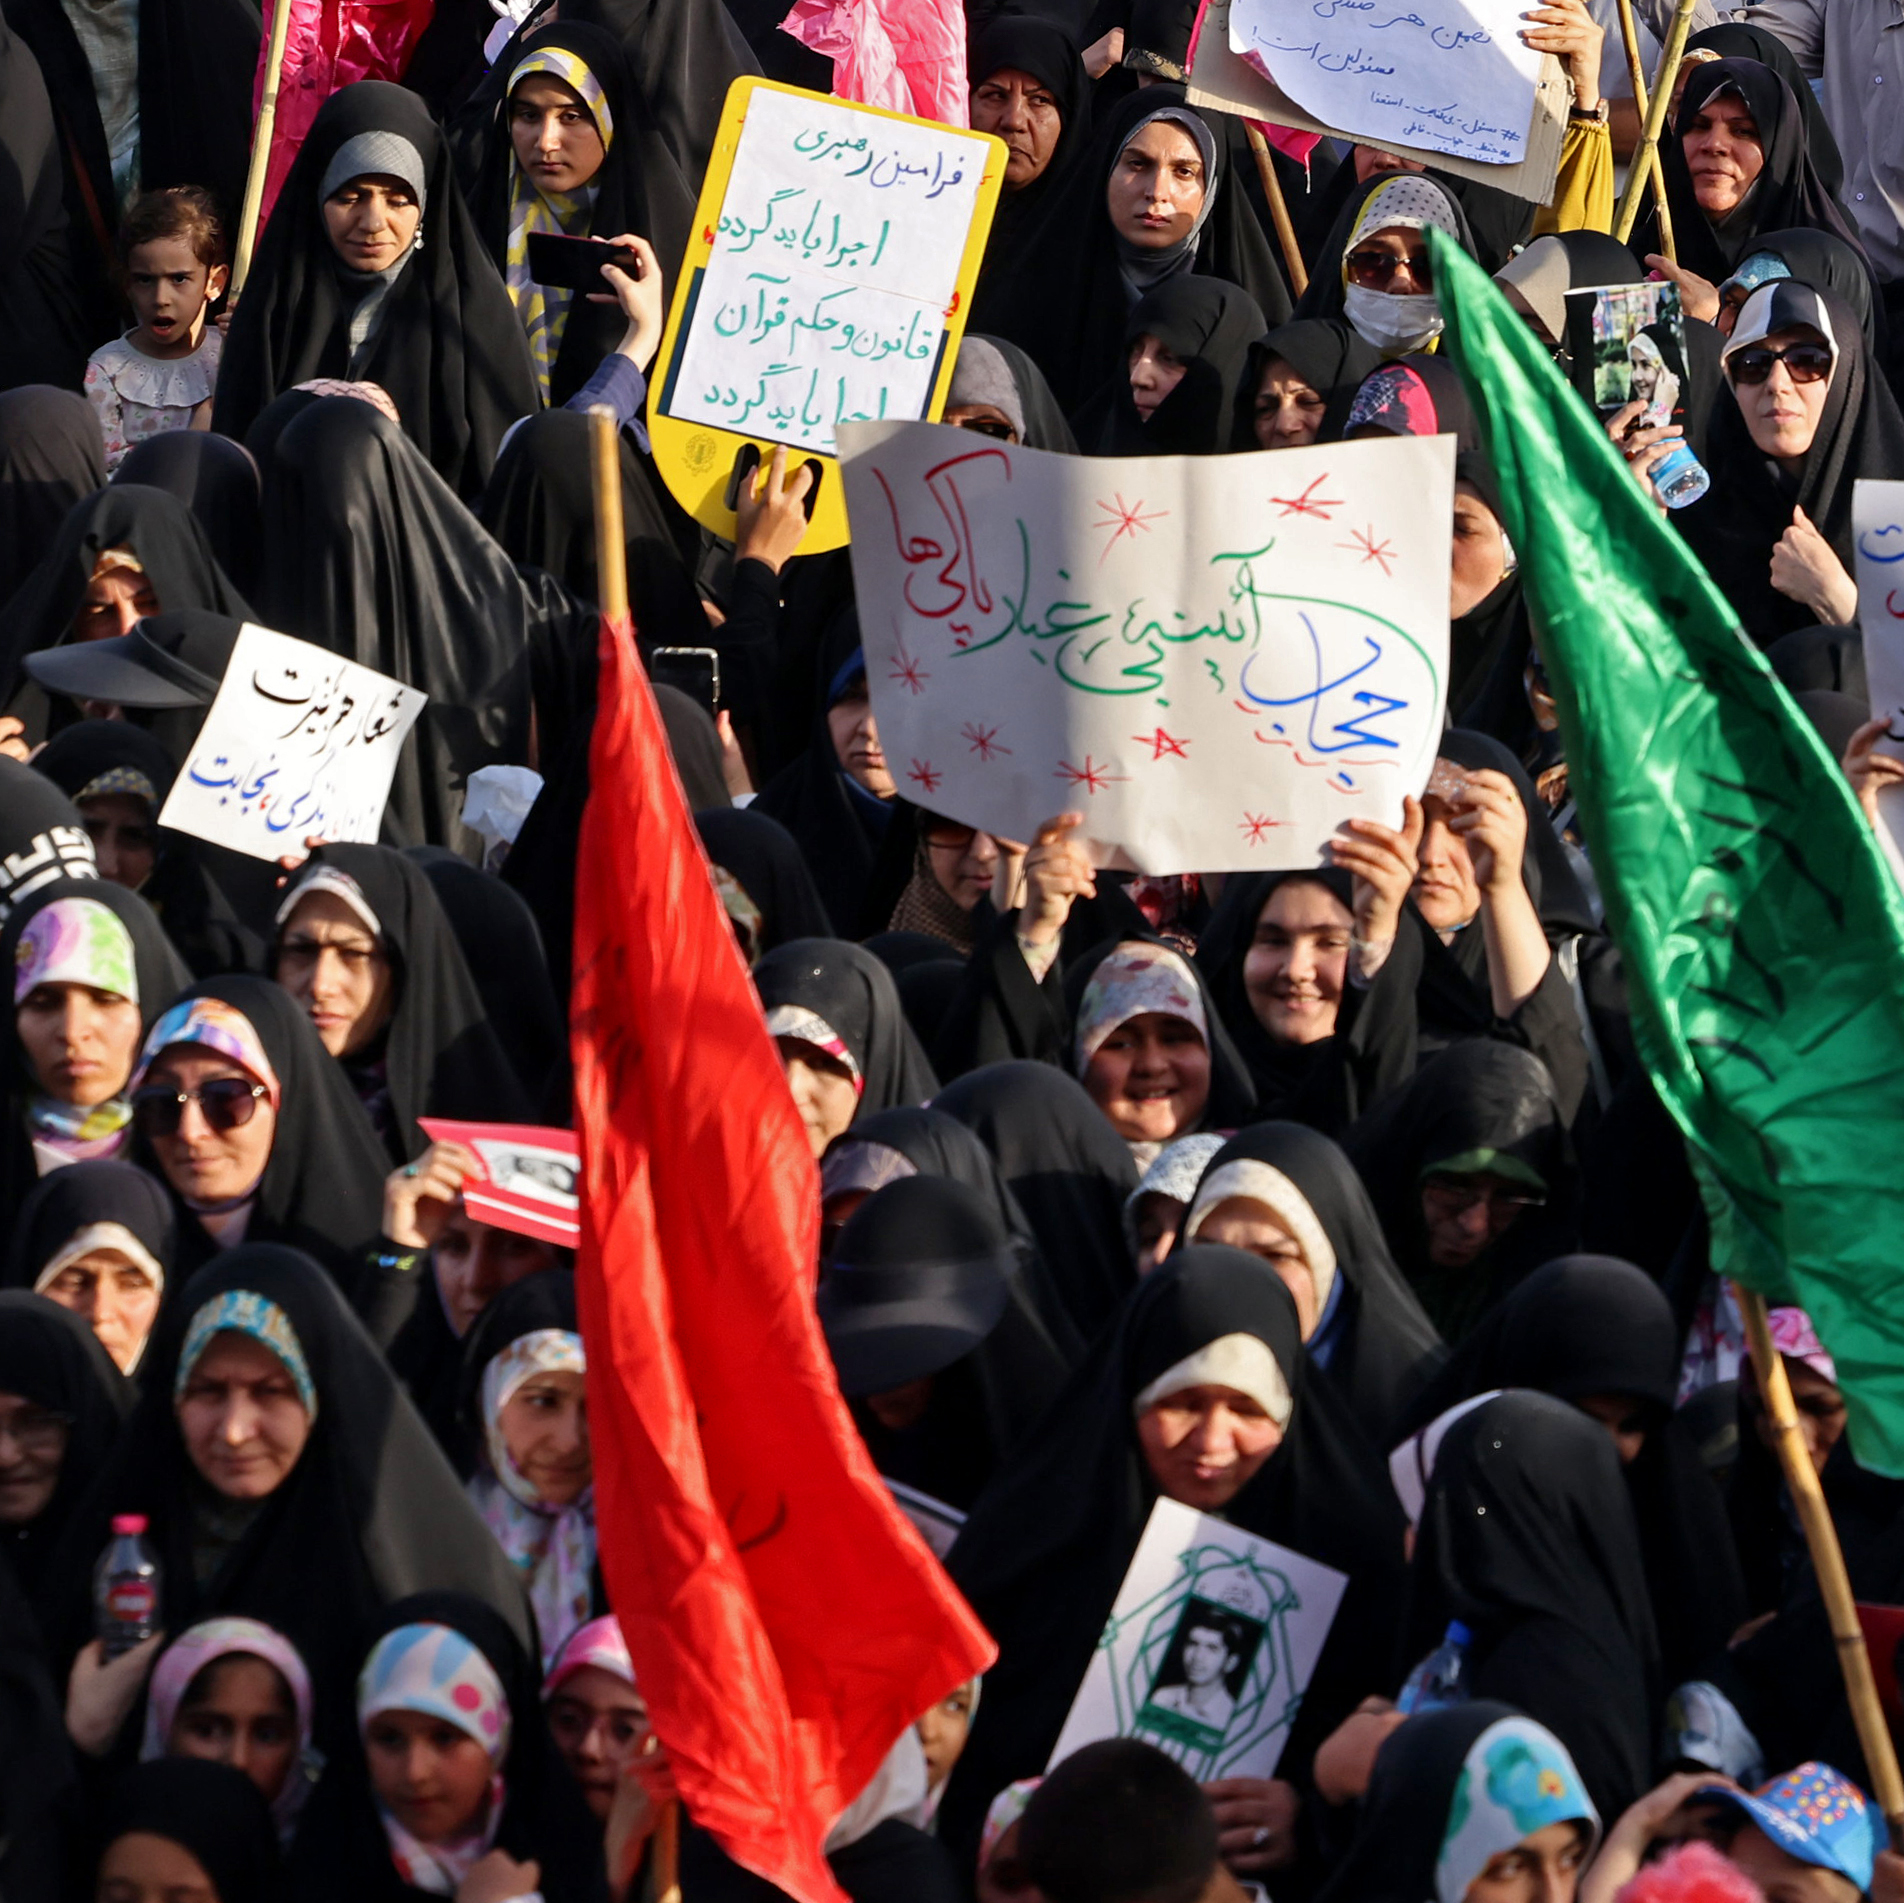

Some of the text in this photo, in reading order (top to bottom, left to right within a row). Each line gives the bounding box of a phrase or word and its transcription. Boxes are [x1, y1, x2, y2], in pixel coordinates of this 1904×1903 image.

[717, 188, 890, 267] اجرا باید گردد
[713, 272, 933, 361] قانون و حکم قرآن
[703, 363, 803, 424] گردد
[1241, 610, 1409, 788] حجاب
